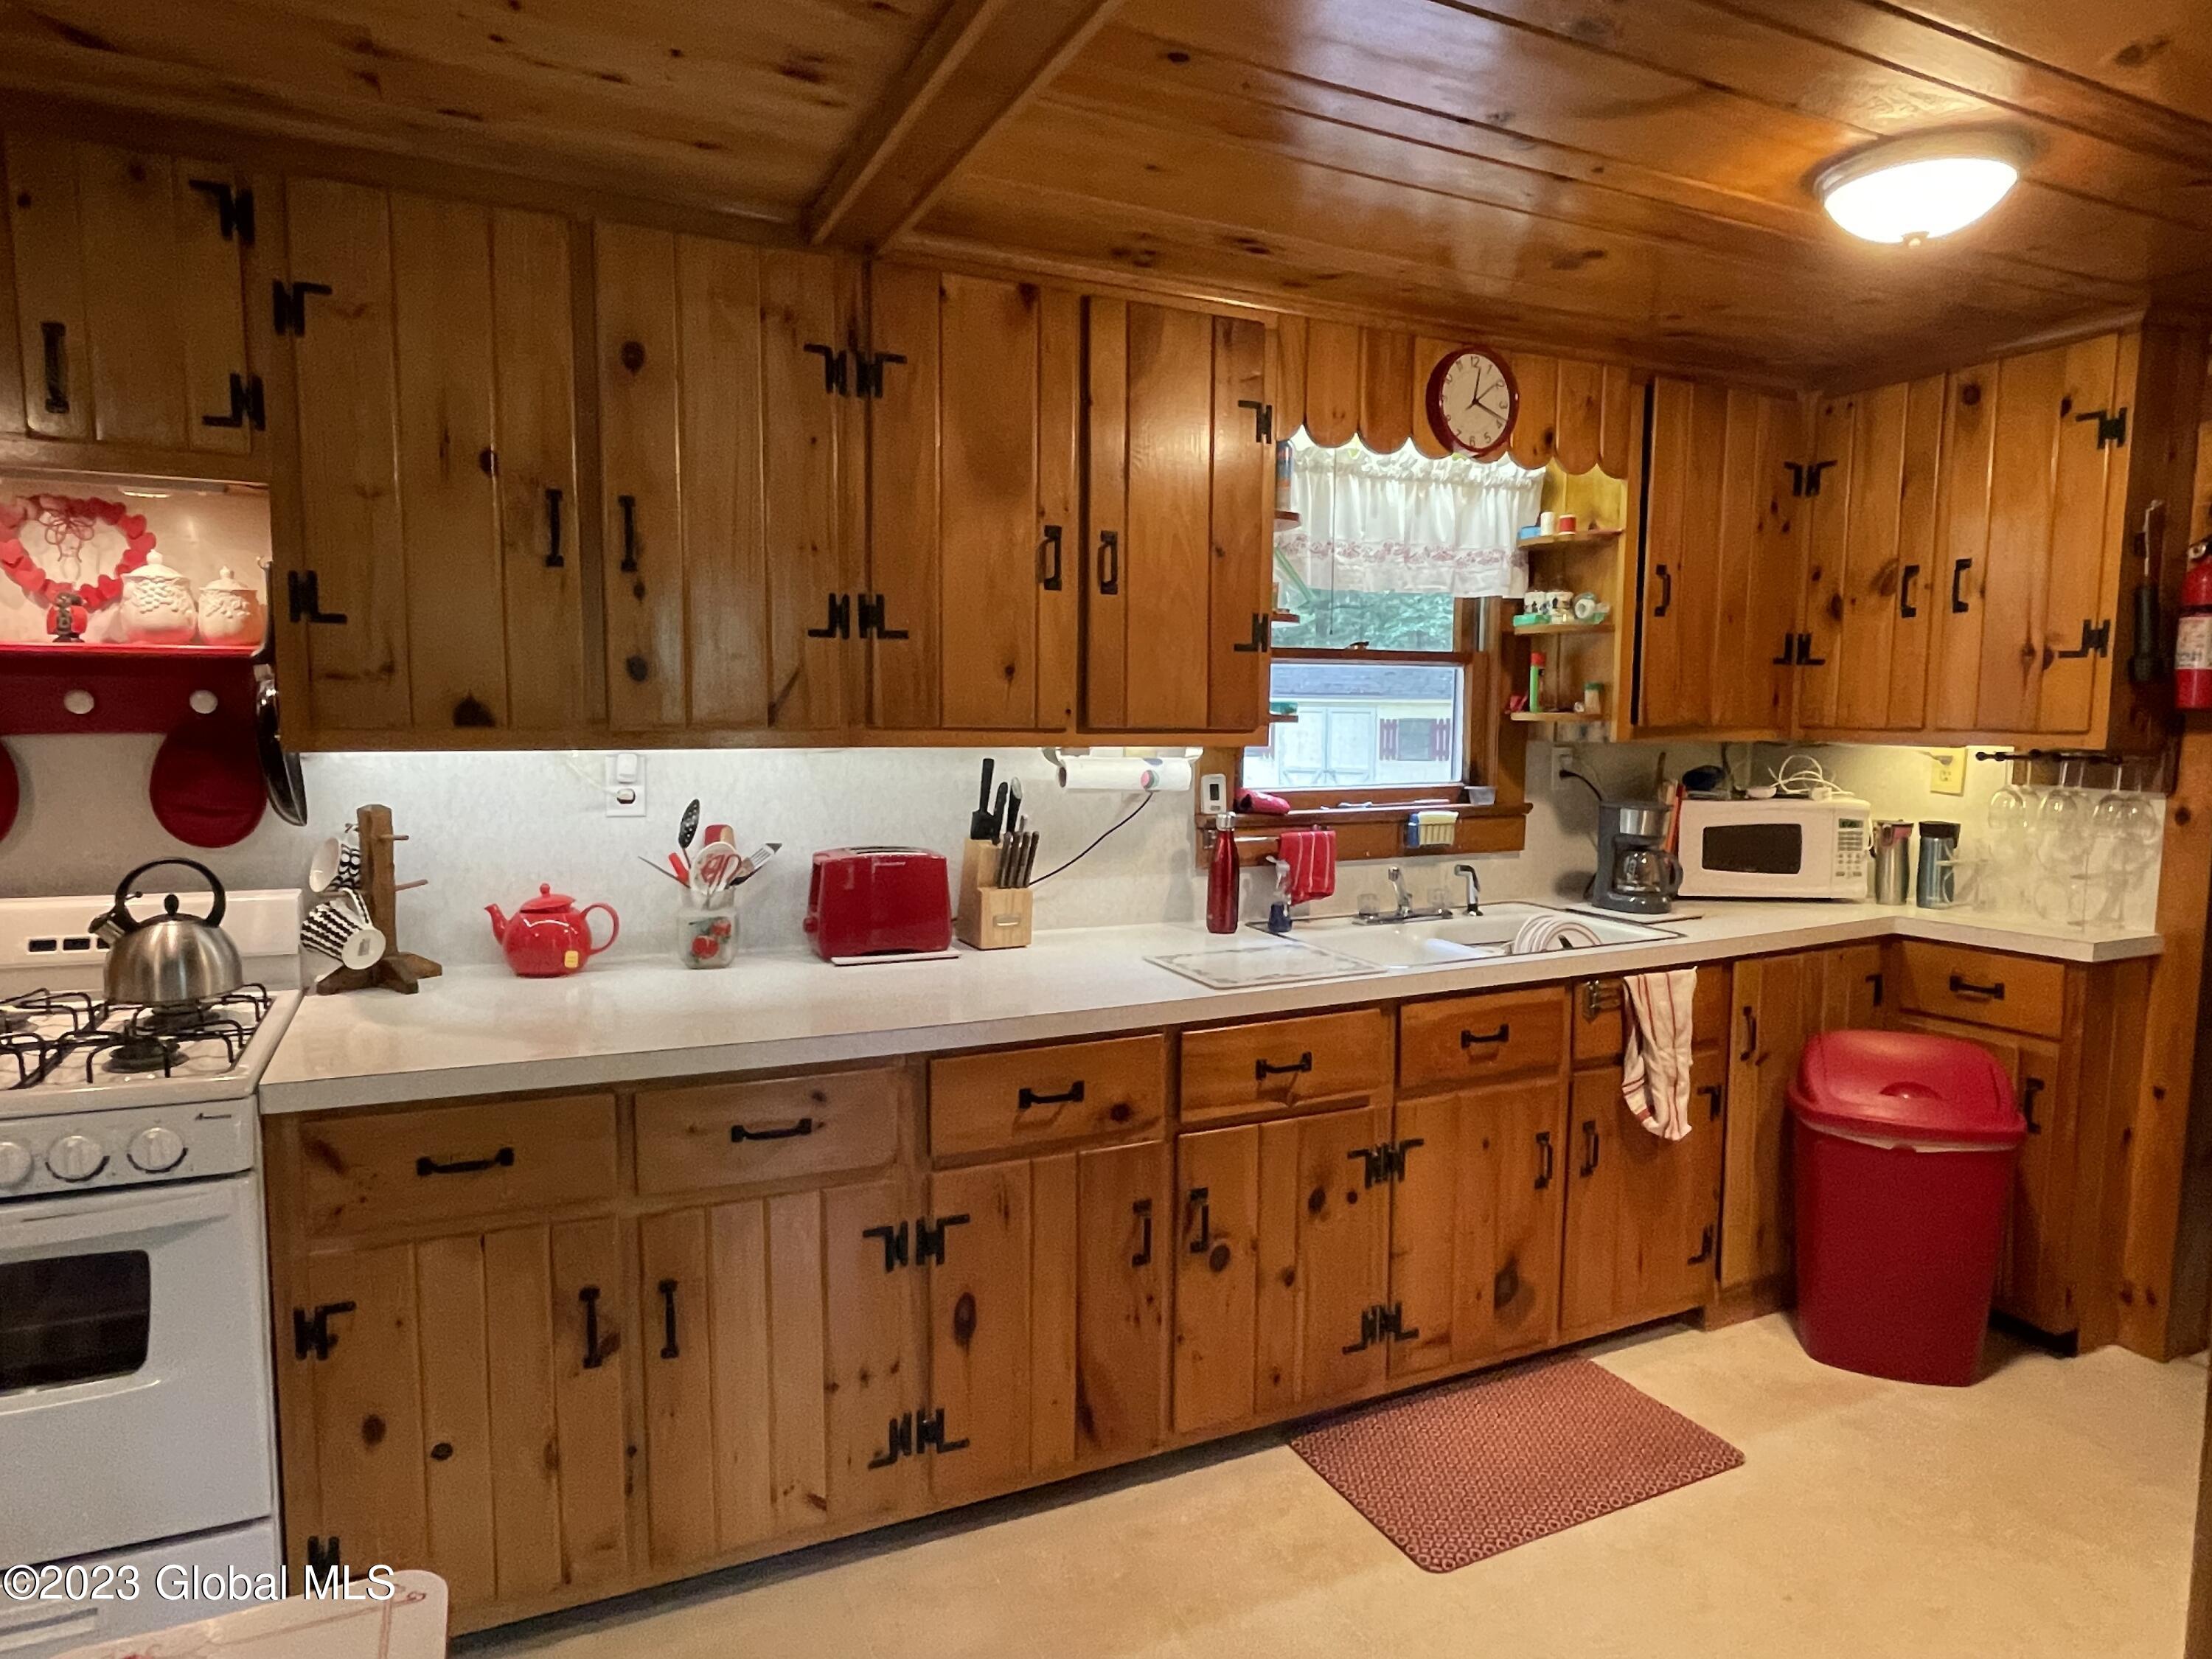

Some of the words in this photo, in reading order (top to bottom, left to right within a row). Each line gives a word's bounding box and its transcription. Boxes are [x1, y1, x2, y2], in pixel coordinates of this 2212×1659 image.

[1470, 355, 1481, 368] 12
[1486, 364, 1493, 375] 1
[1499, 401, 1508, 409] 3
[1495, 420, 1503, 429] 4
[1456, 428, 1462, 437] 7
[1484, 432, 1492, 443] 5
[1470, 436, 1476, 447] 6
